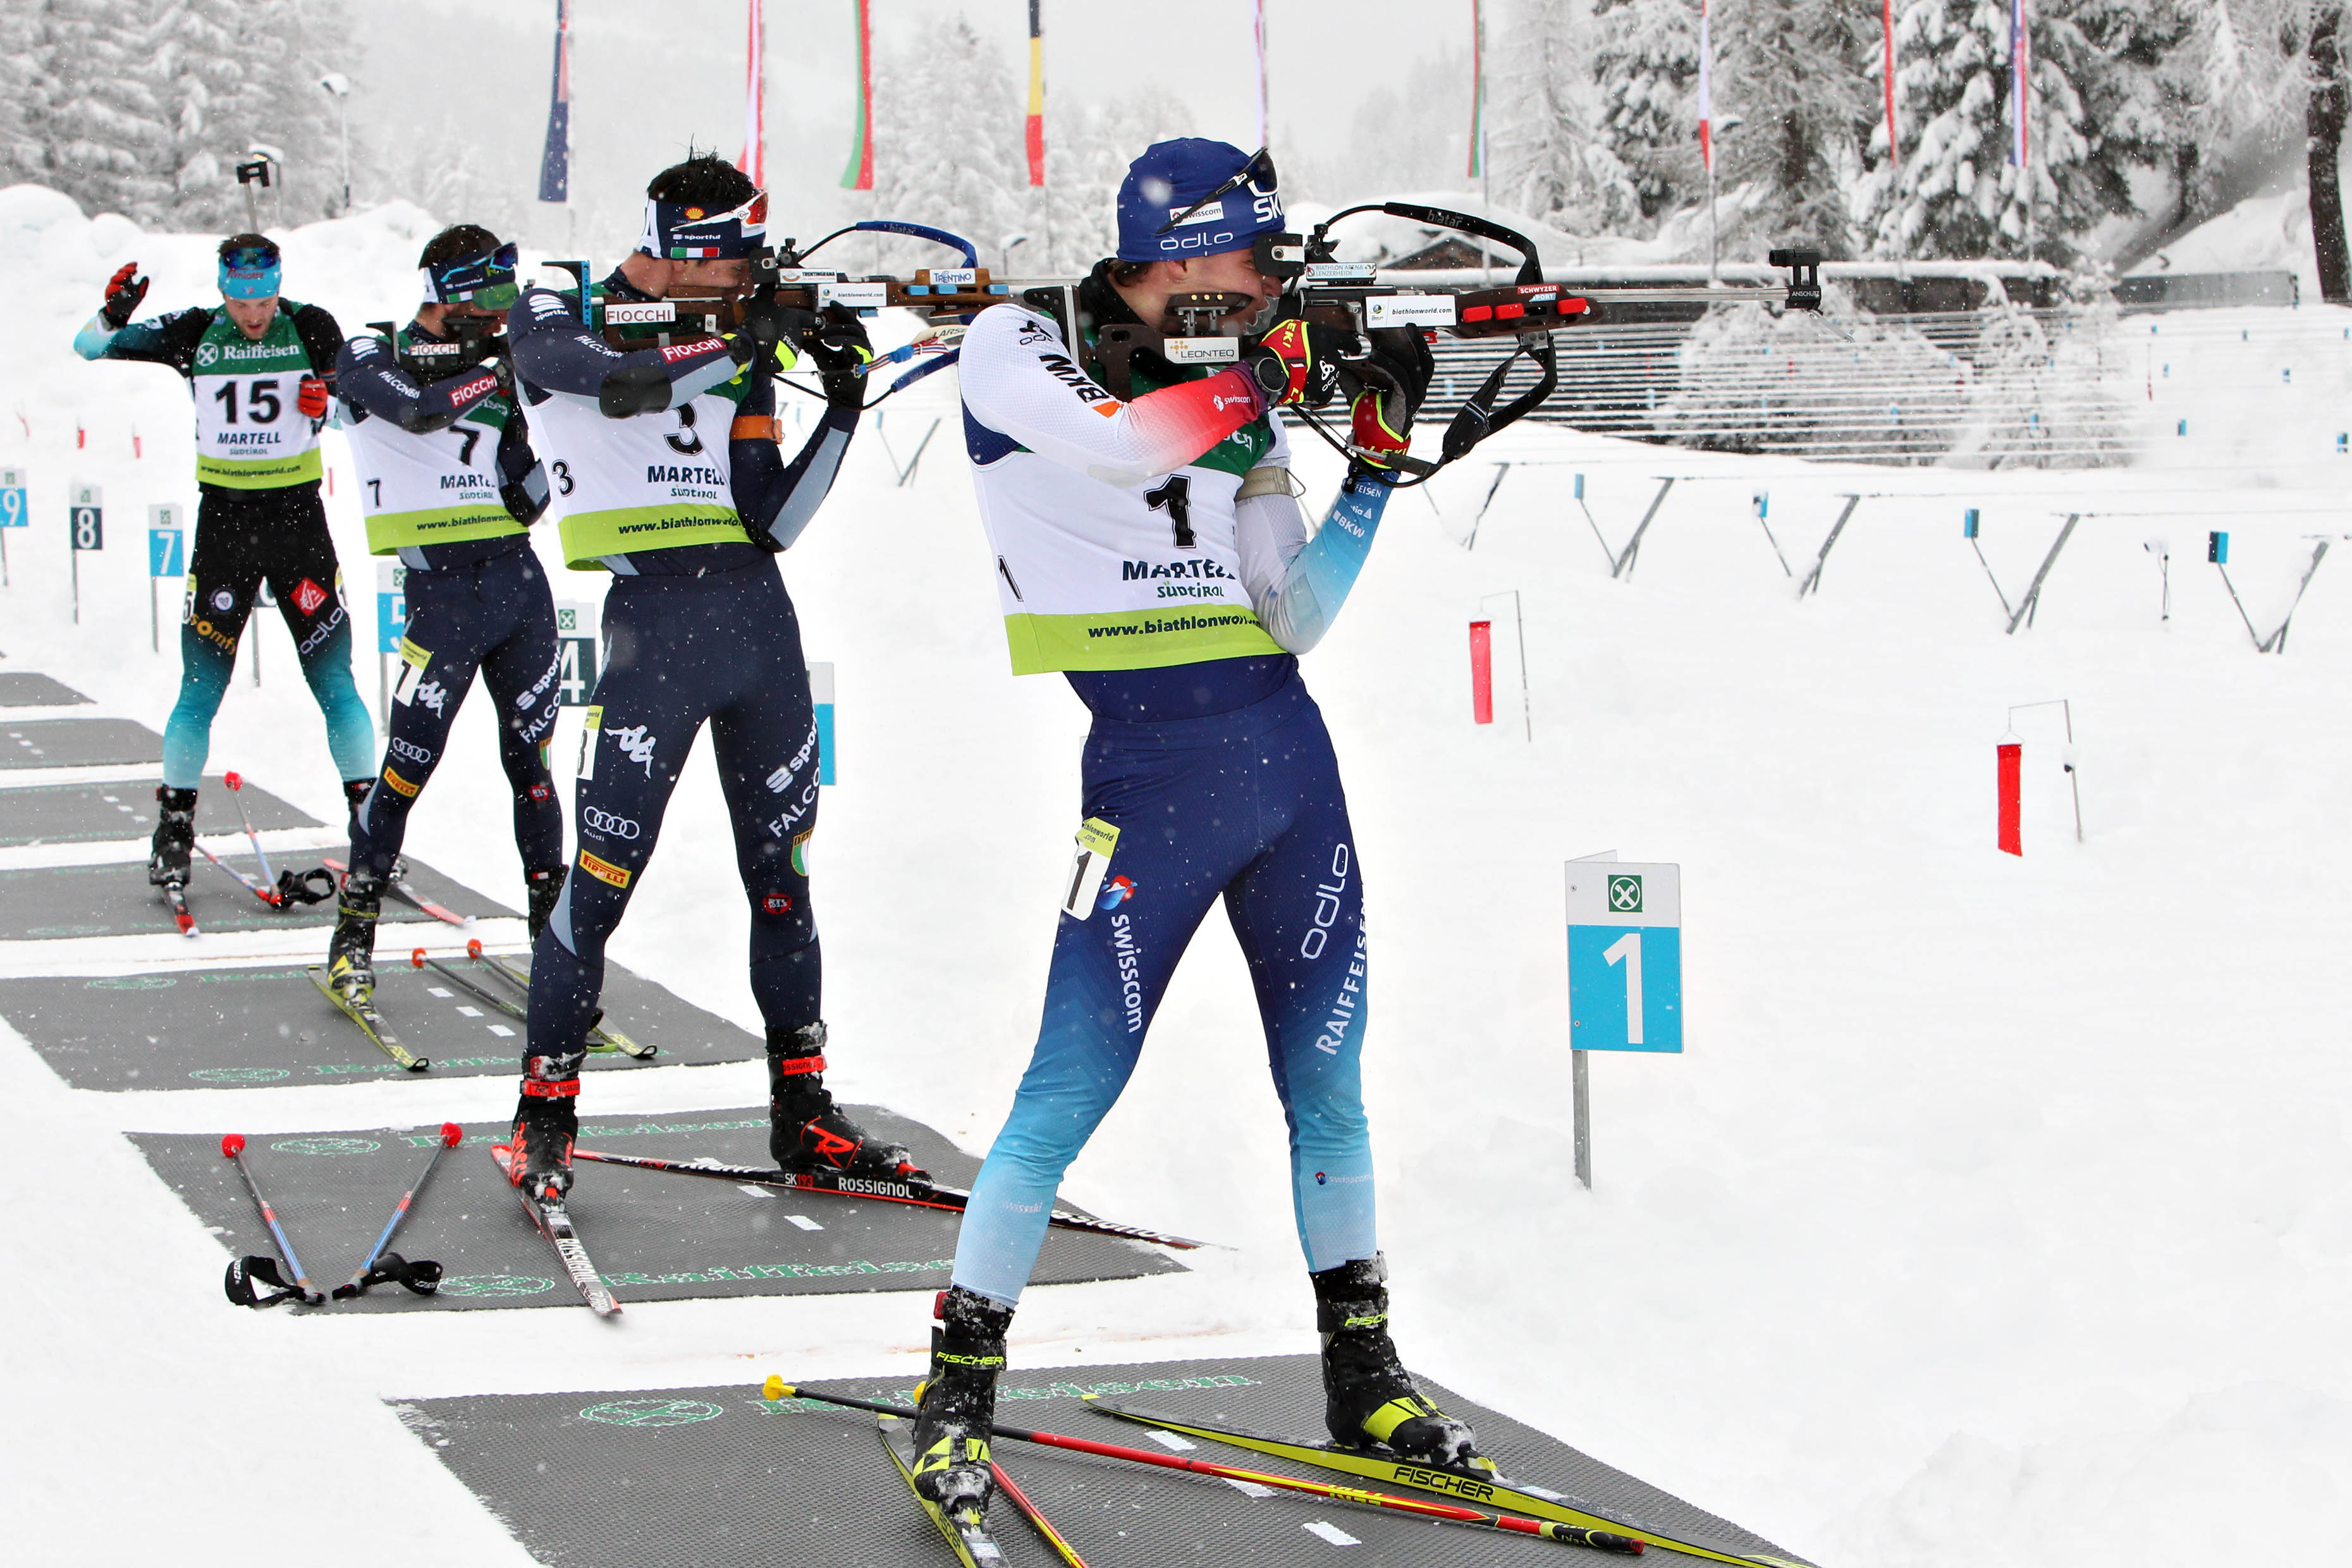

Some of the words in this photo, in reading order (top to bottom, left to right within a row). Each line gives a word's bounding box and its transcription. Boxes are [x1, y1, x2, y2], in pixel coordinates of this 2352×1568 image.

[1160, 232, 1234, 251] odlo
[933, 270, 972, 284] TRENTINO
[534, 309, 570, 322] sportful
[607, 309, 671, 322] FIOCCHI
[1392, 307, 1452, 315] biathlonworld.com
[410, 344, 460, 356] FIOCCHI
[663, 338, 723, 362] FIOCCHI
[1282, 322, 1297, 348] EKI
[223, 345, 300, 360] Raiffeisen
[1180, 349, 1235, 358] LEONTEQ
[451, 377, 498, 407] FIOCCHI
[1039, 354, 1109, 403] BKW
[215, 379, 281, 424] 15
[217, 432, 281, 445] MARTELL
[448, 424, 481, 467] 7
[663, 403, 704, 456] 3
[366, 477, 382, 509] 7
[551, 459, 576, 498] 3
[3, 489, 21, 526] 9
[1143, 473, 1197, 549] 1
[77, 508, 97, 549] 8
[1339, 515, 1365, 539] BKW
[157, 530, 176, 575] 7
[997, 554, 1024, 603] 1
[190, 613, 237, 656] somfy
[300, 606, 344, 655] odlo
[560, 640, 585, 704] 4
[583, 828, 604, 842] Audi
[583, 854, 626, 885] PIRELLI
[1067, 850, 1093, 911] 1
[1300, 843, 1349, 960] odlo
[1111, 914, 1142, 1034] swisscom
[1603, 933, 1644, 1044] 1
[785, 1173, 814, 1187] SK193
[599, 1259, 955, 1287] Raiffeise
[936, 1351, 1005, 1366] FISCHER
[1393, 1466, 1495, 1502] FISCHER
